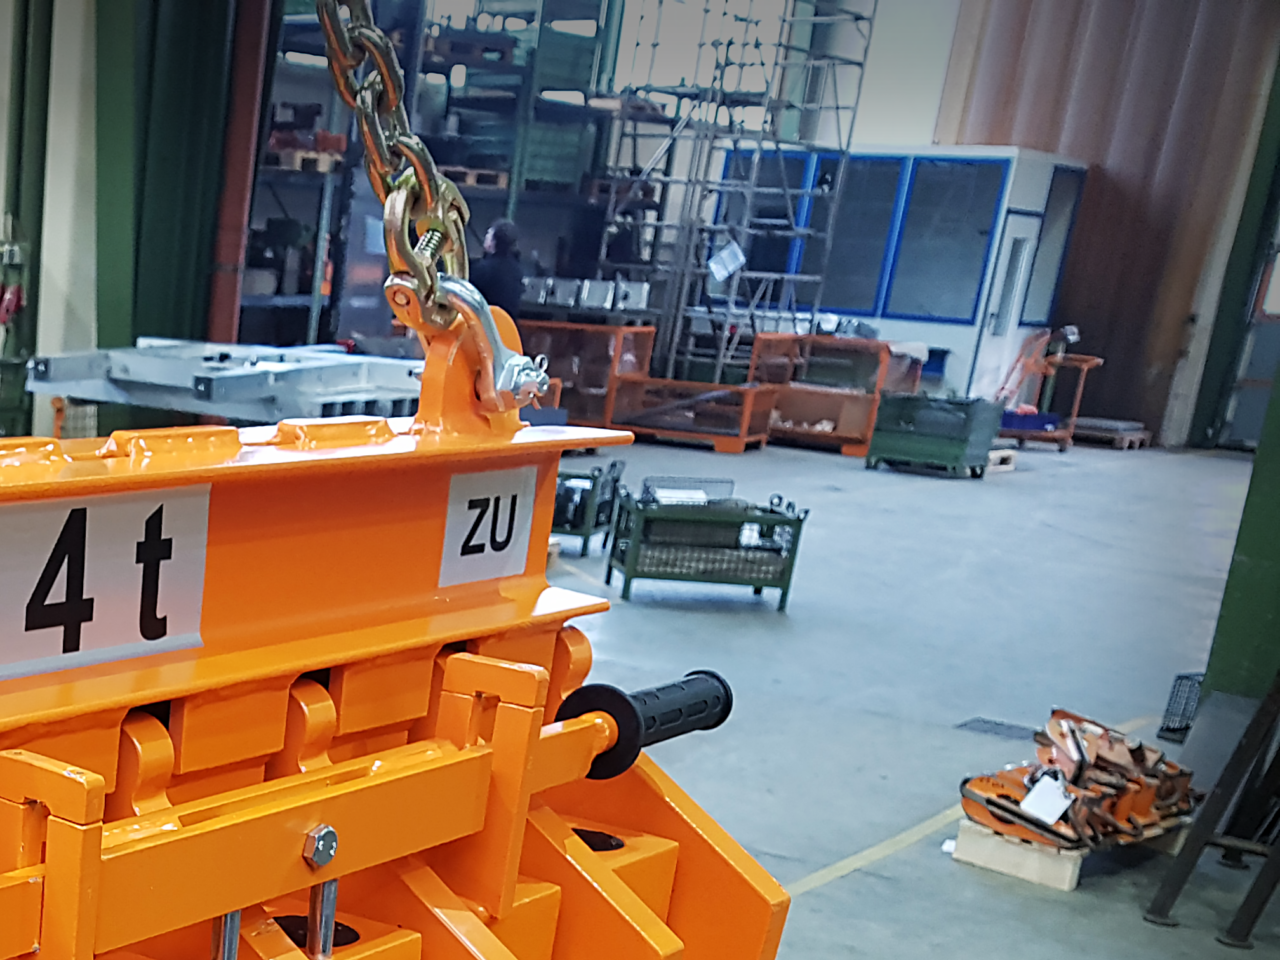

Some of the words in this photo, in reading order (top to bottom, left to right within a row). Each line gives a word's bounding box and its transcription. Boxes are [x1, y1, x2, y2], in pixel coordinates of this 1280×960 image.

[24, 506, 95, 654] 4
[134, 503, 174, 641] t
[460, 493, 518, 557] ZU
